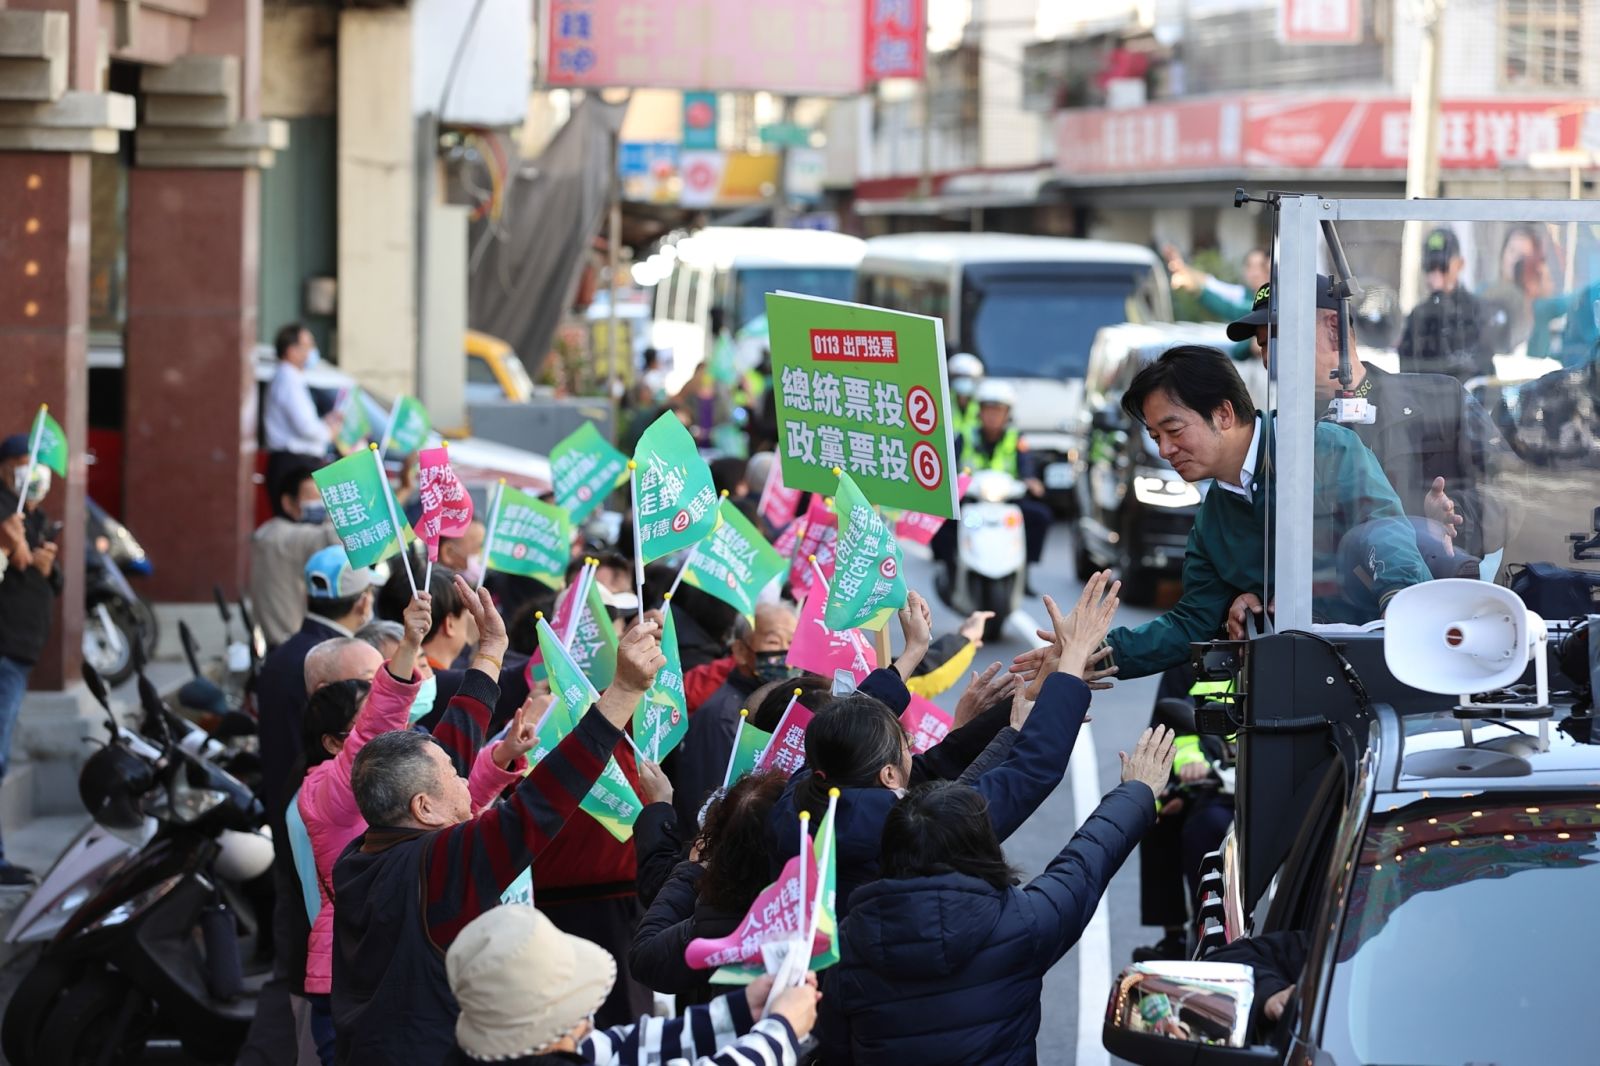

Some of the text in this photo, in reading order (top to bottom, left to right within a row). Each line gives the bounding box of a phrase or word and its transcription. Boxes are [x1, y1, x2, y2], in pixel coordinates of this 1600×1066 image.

[814, 335, 895, 358] 0113 出門投票
